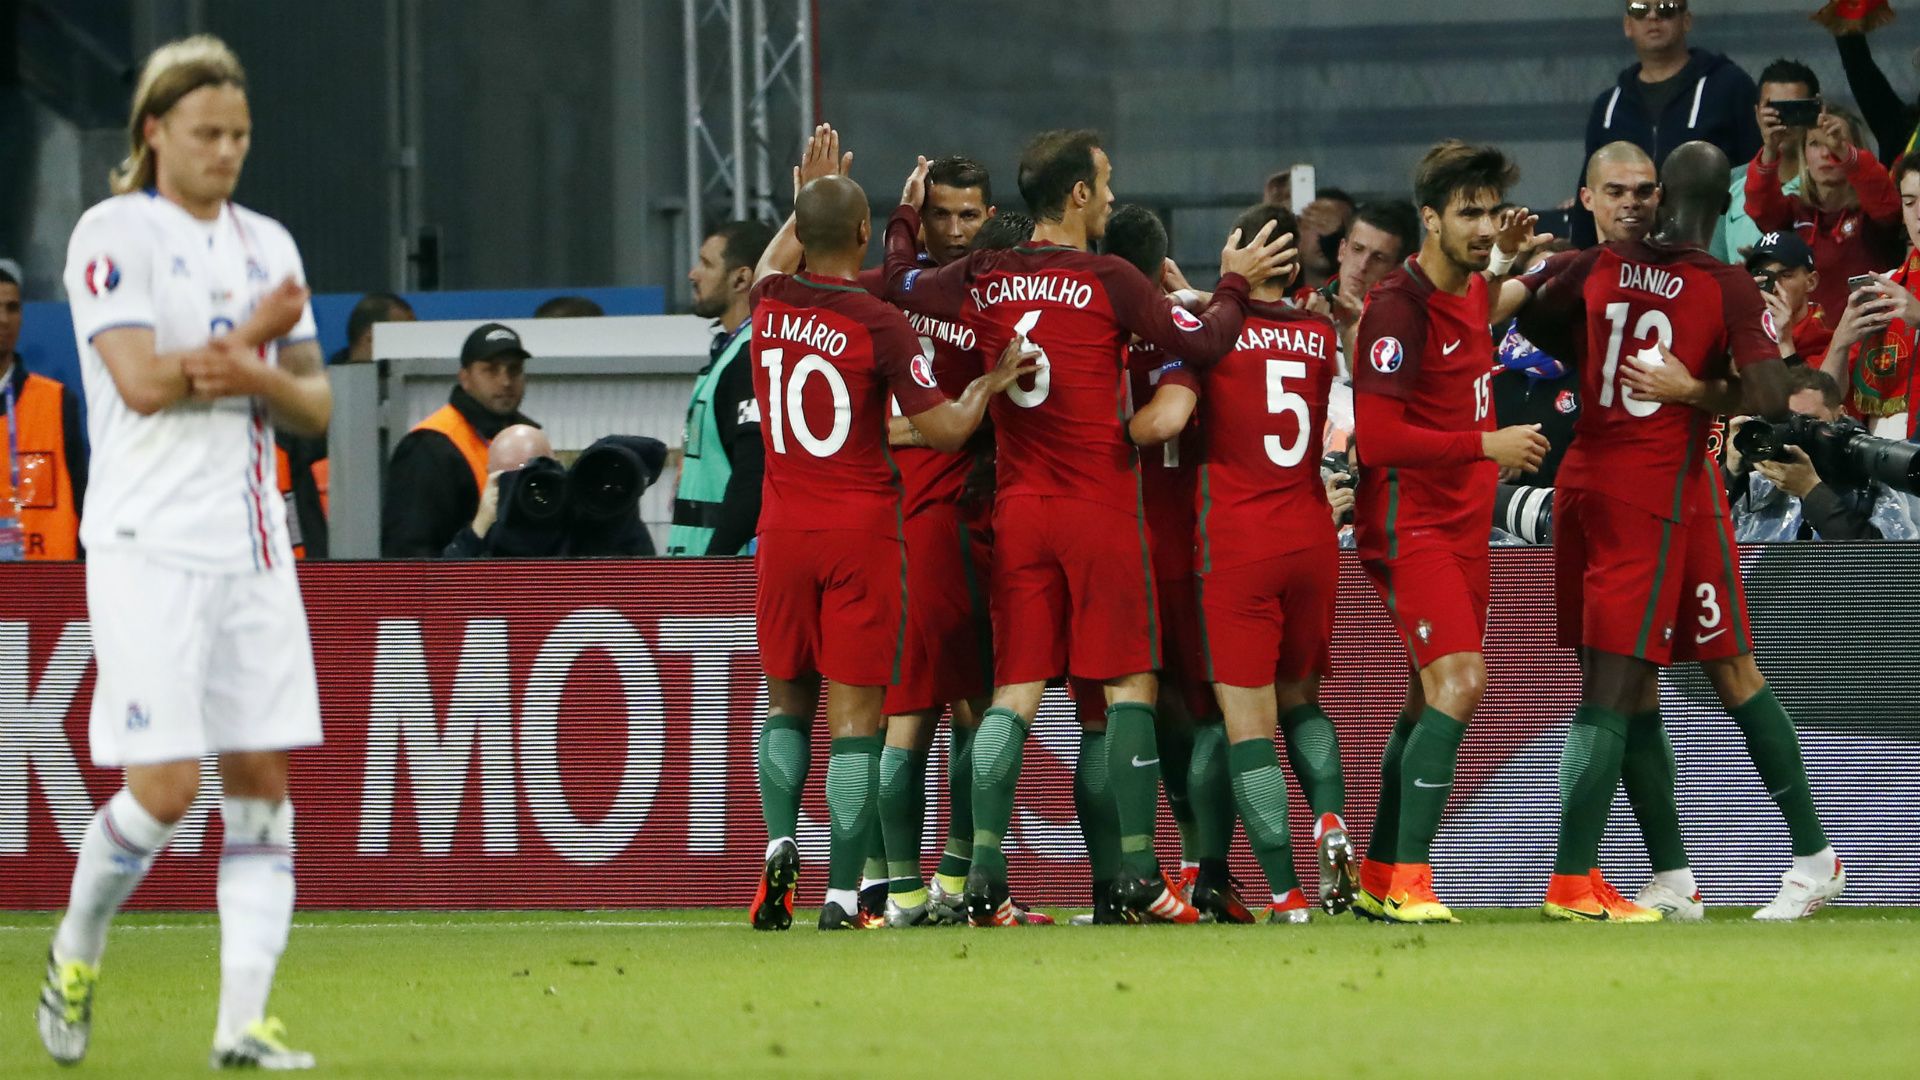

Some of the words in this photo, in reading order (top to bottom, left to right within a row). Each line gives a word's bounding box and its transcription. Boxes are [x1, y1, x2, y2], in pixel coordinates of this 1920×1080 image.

[1619, 262, 1684, 300] DANILO
[761, 312, 777, 338] J.
[780, 313, 848, 357] MÁRIO
[1006, 309, 1051, 409] 6
[1599, 302, 1673, 417] 13
[761, 347, 852, 458] 10
[1263, 358, 1312, 469] 5
[1473, 371, 1491, 422] 15
[1695, 582, 1721, 629] 3
